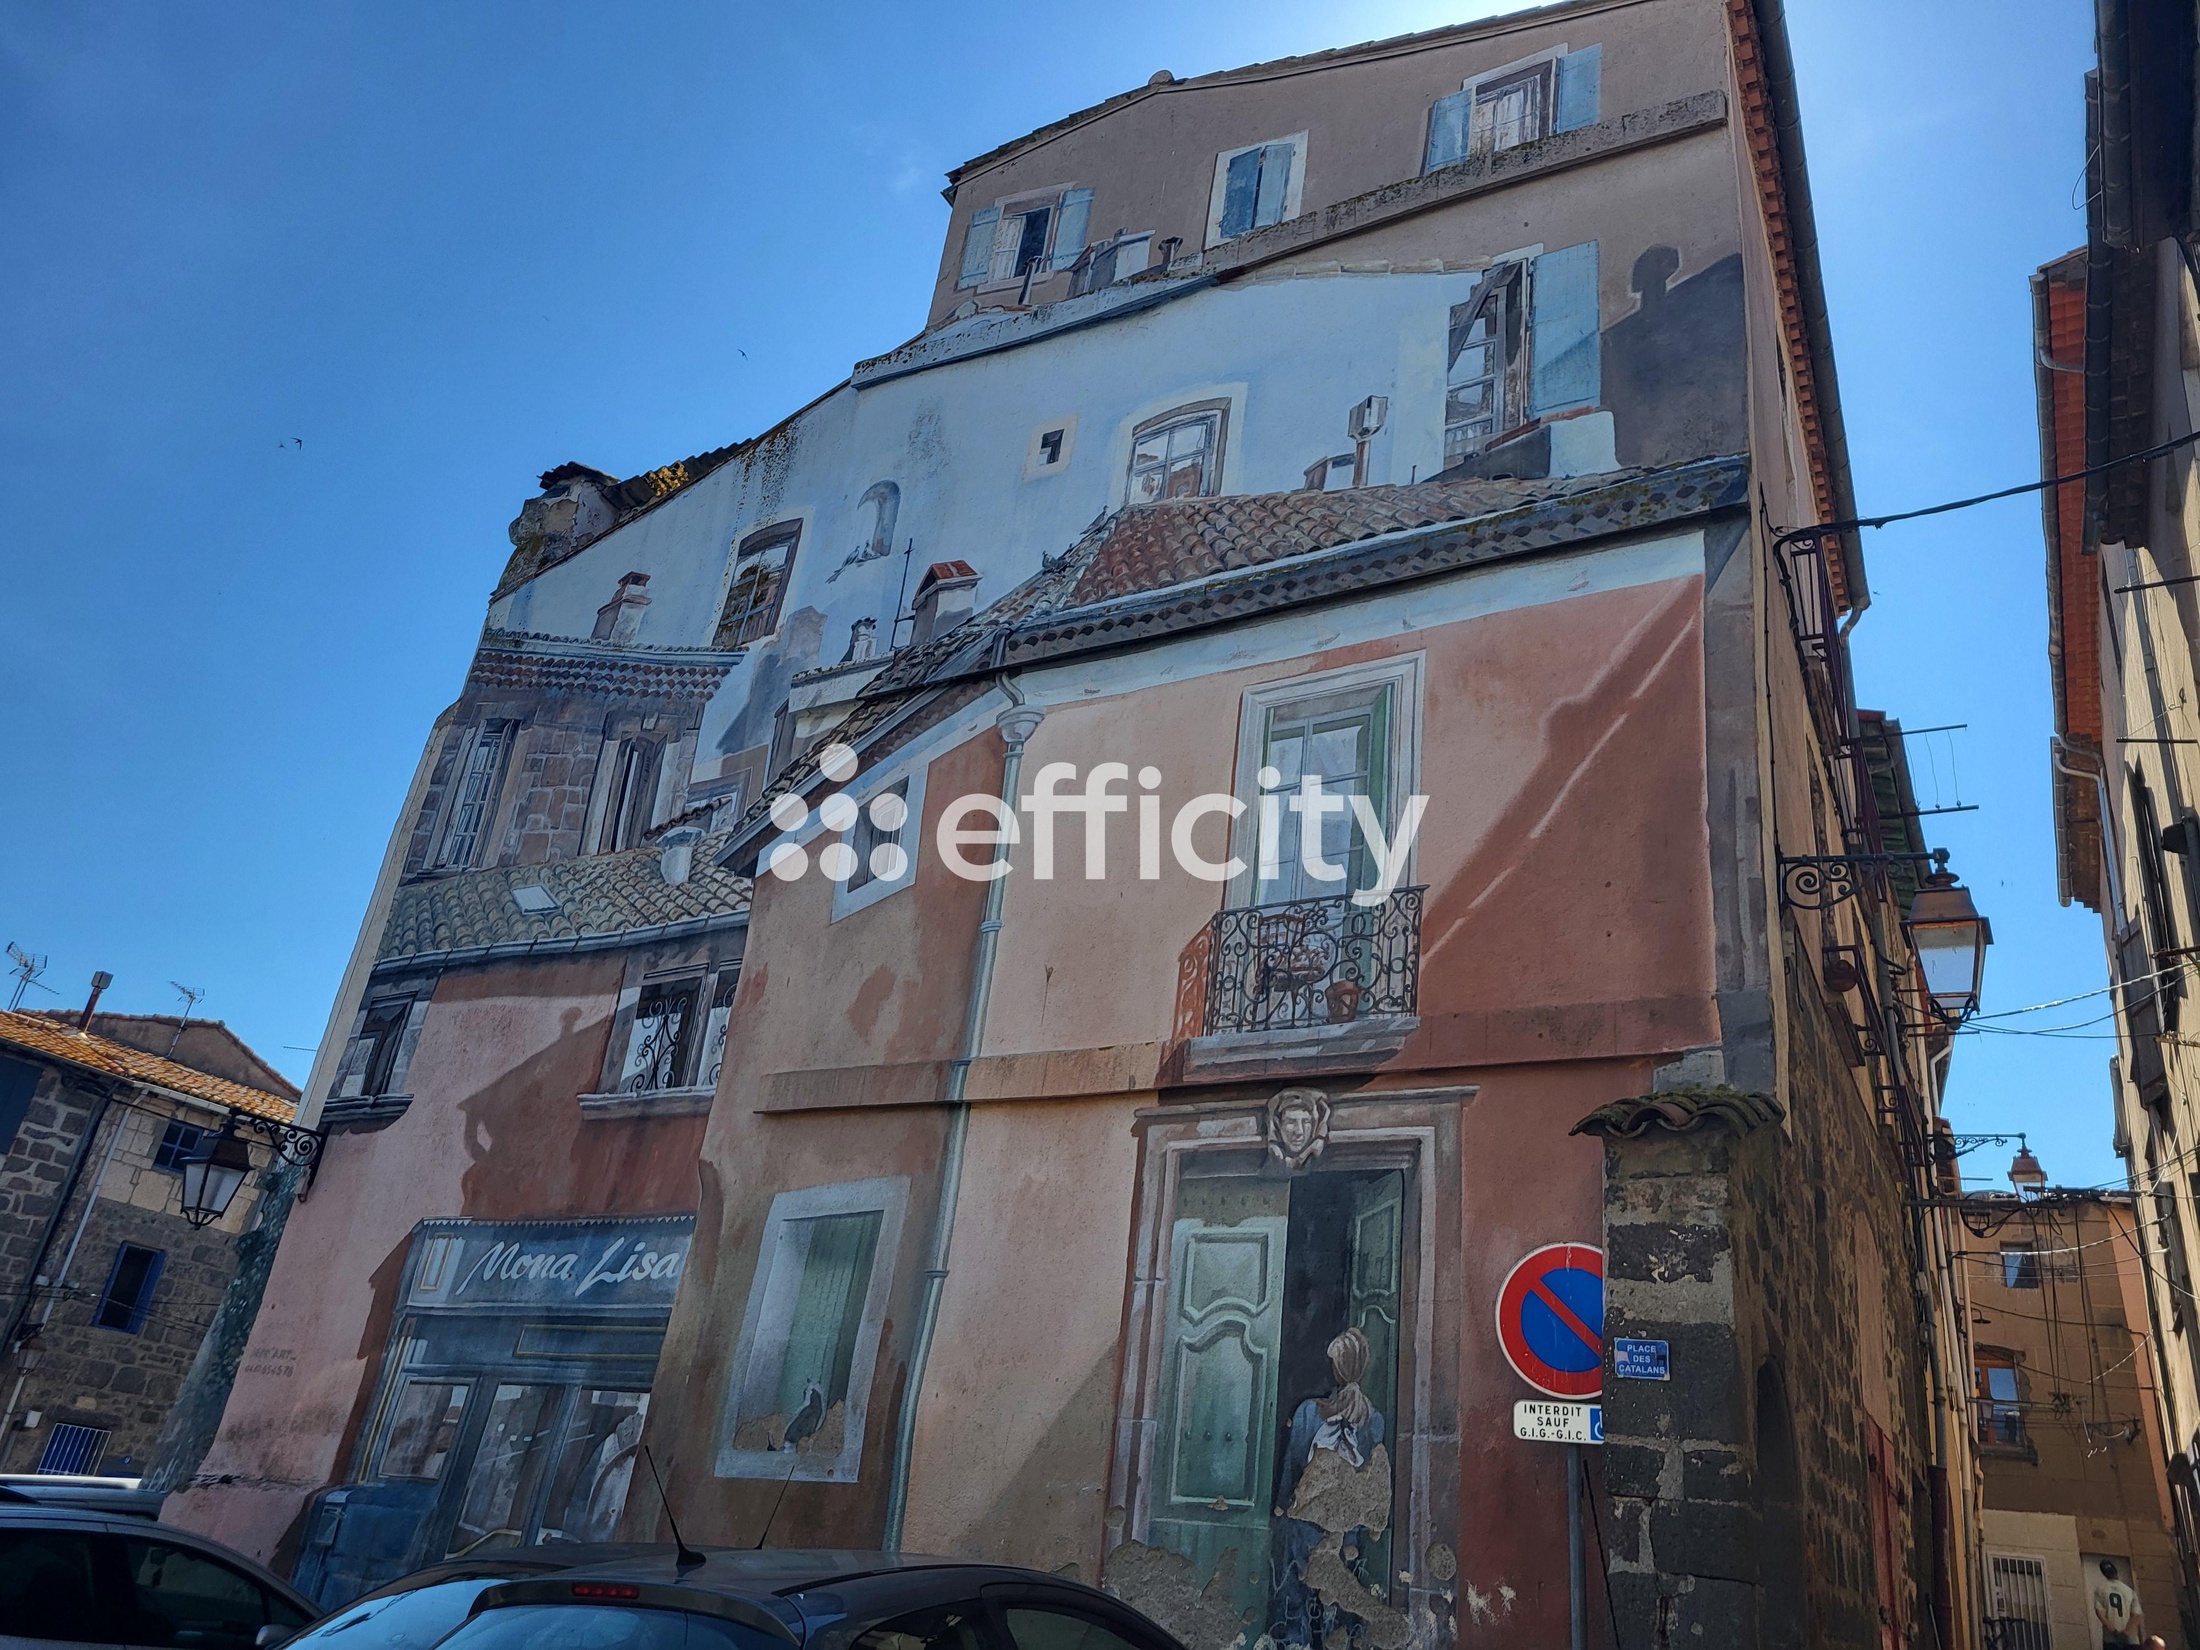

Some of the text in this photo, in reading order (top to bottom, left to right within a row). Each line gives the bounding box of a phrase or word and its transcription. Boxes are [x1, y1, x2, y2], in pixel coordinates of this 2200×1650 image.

[455, 1236, 680, 1297] Mona Lisa
[1627, 1344, 1656, 1353] PLACE
[1632, 1355, 1651, 1363] DES
[1618, 1364, 1666, 1374] CATALANS
[1523, 1404, 1582, 1417] INTERDIT
[1537, 1416, 1570, 1427] SAUF
[2109, 1592, 2123, 1617] 9
